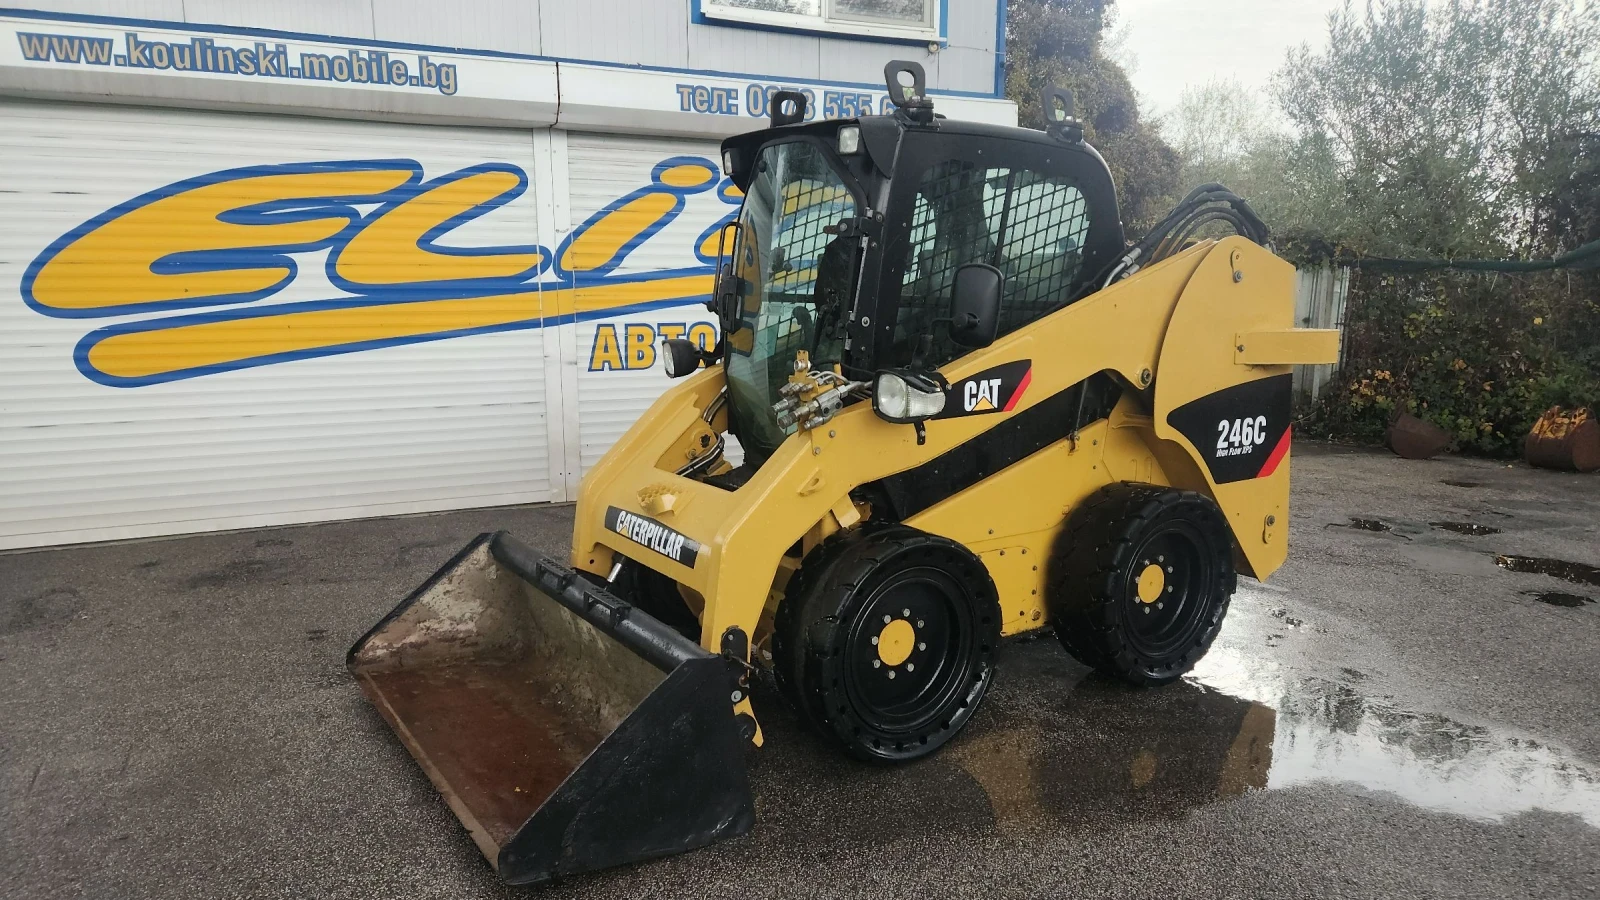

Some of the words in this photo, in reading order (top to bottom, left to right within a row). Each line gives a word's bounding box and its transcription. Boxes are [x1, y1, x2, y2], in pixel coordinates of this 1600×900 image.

[17, 31, 458, 96] www.koulinski.mobile.bg
[676, 84, 739, 115] тел:
[823, 91, 873, 119] 555
[964, 378, 1002, 412] CAT
[1216, 415, 1267, 449] 246C
[616, 510, 685, 561] CATERPILLAR
